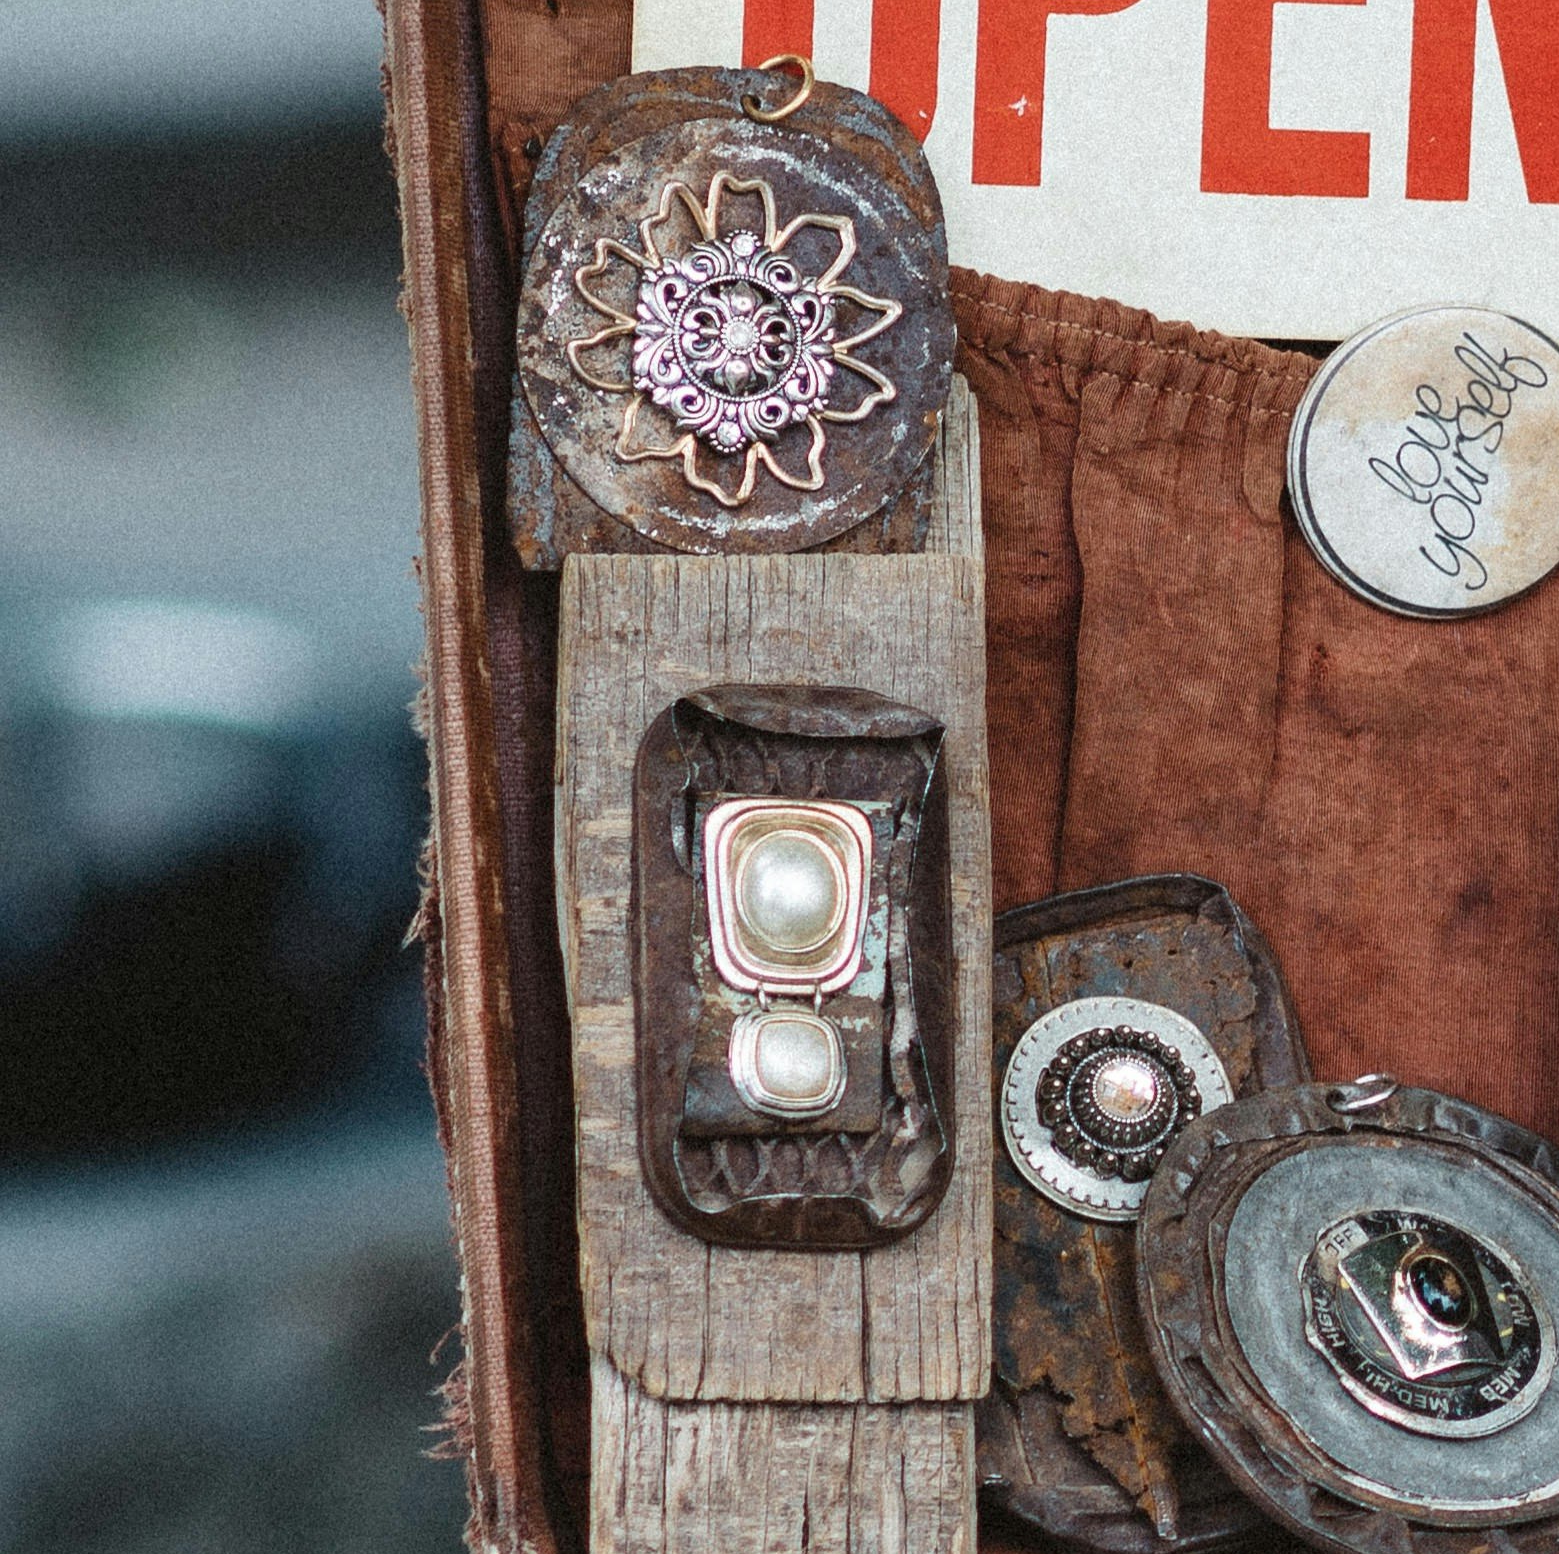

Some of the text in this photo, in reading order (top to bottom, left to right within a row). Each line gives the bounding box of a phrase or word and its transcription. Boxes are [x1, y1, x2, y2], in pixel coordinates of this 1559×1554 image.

[1368, 384, 1459, 505] love
[1419, 332, 1548, 591] yourself
[1314, 1297, 1346, 1348] HIGH
[1479, 1366, 1521, 1401] MED
